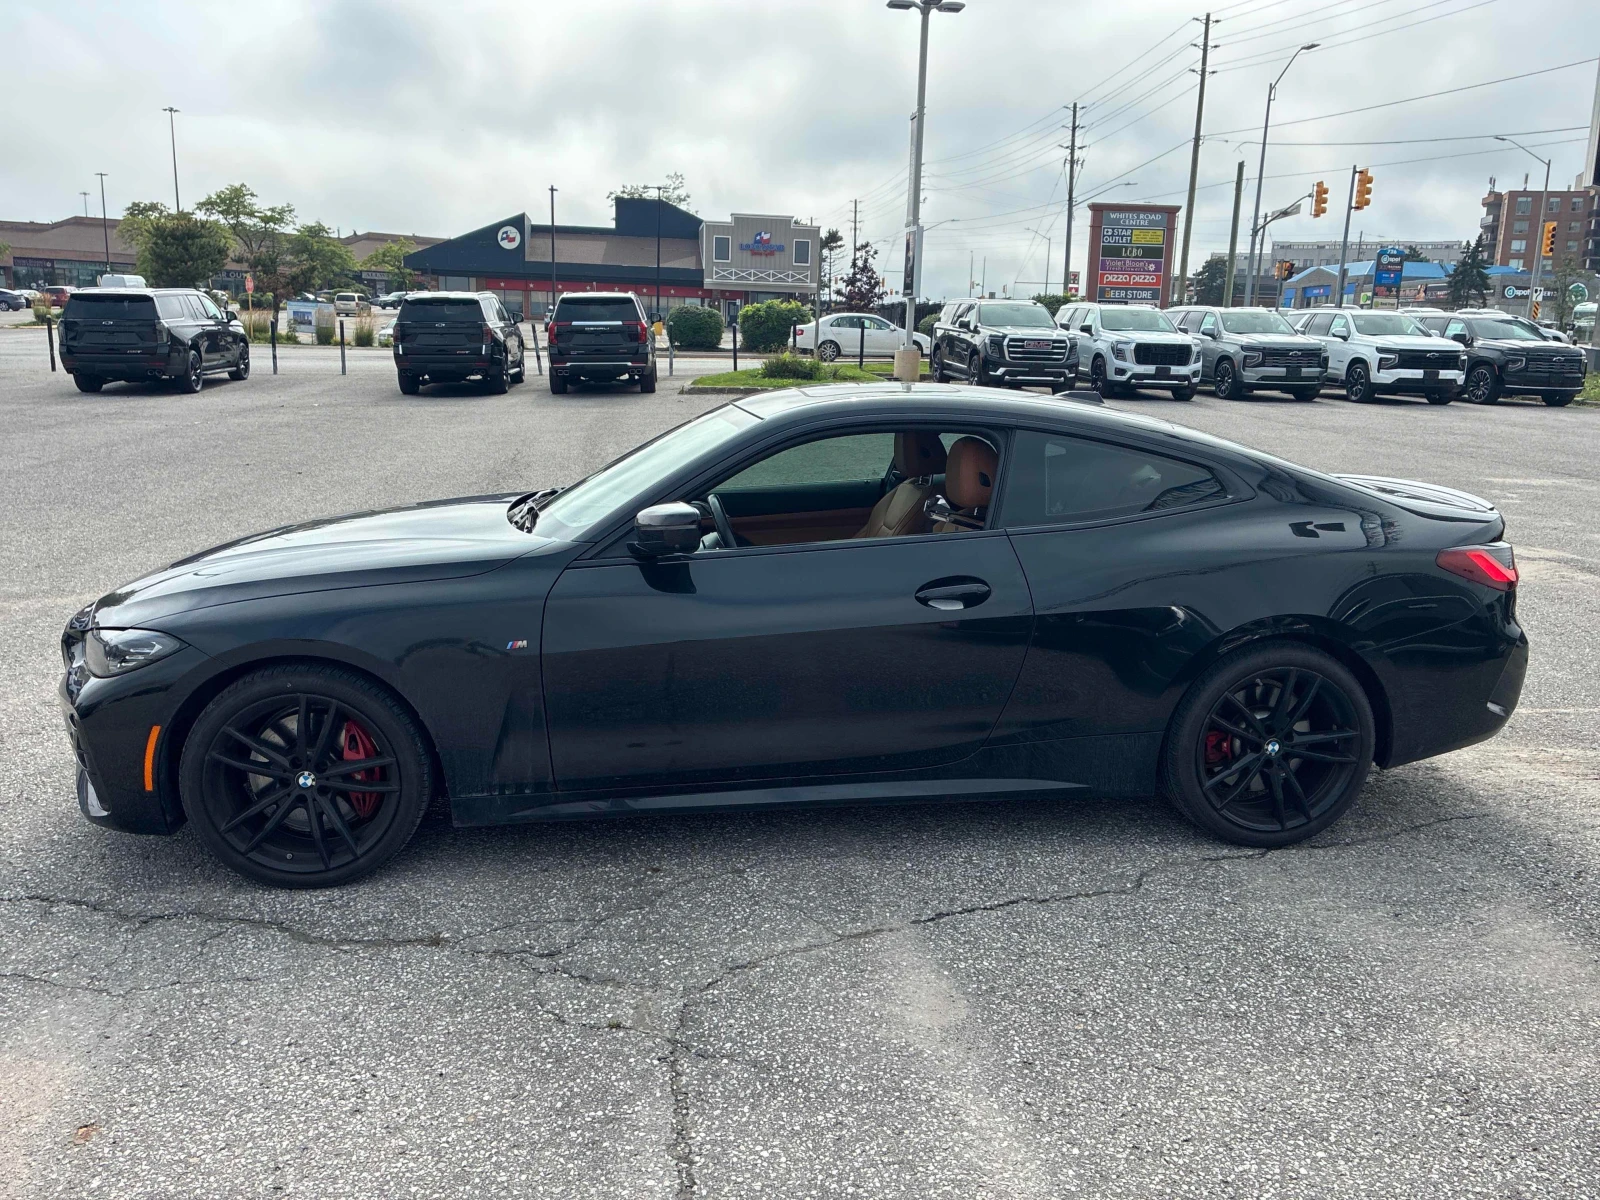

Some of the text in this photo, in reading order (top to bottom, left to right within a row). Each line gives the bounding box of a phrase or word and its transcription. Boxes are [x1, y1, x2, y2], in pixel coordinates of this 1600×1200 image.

[1110, 212, 1137, 220] WHITES
[1113, 228, 1132, 236] STAR
[1122, 248, 1143, 257] LCBO
[1103, 274, 1156, 285] pizza pizza
[1105, 290, 1153, 299] BEER STORE
